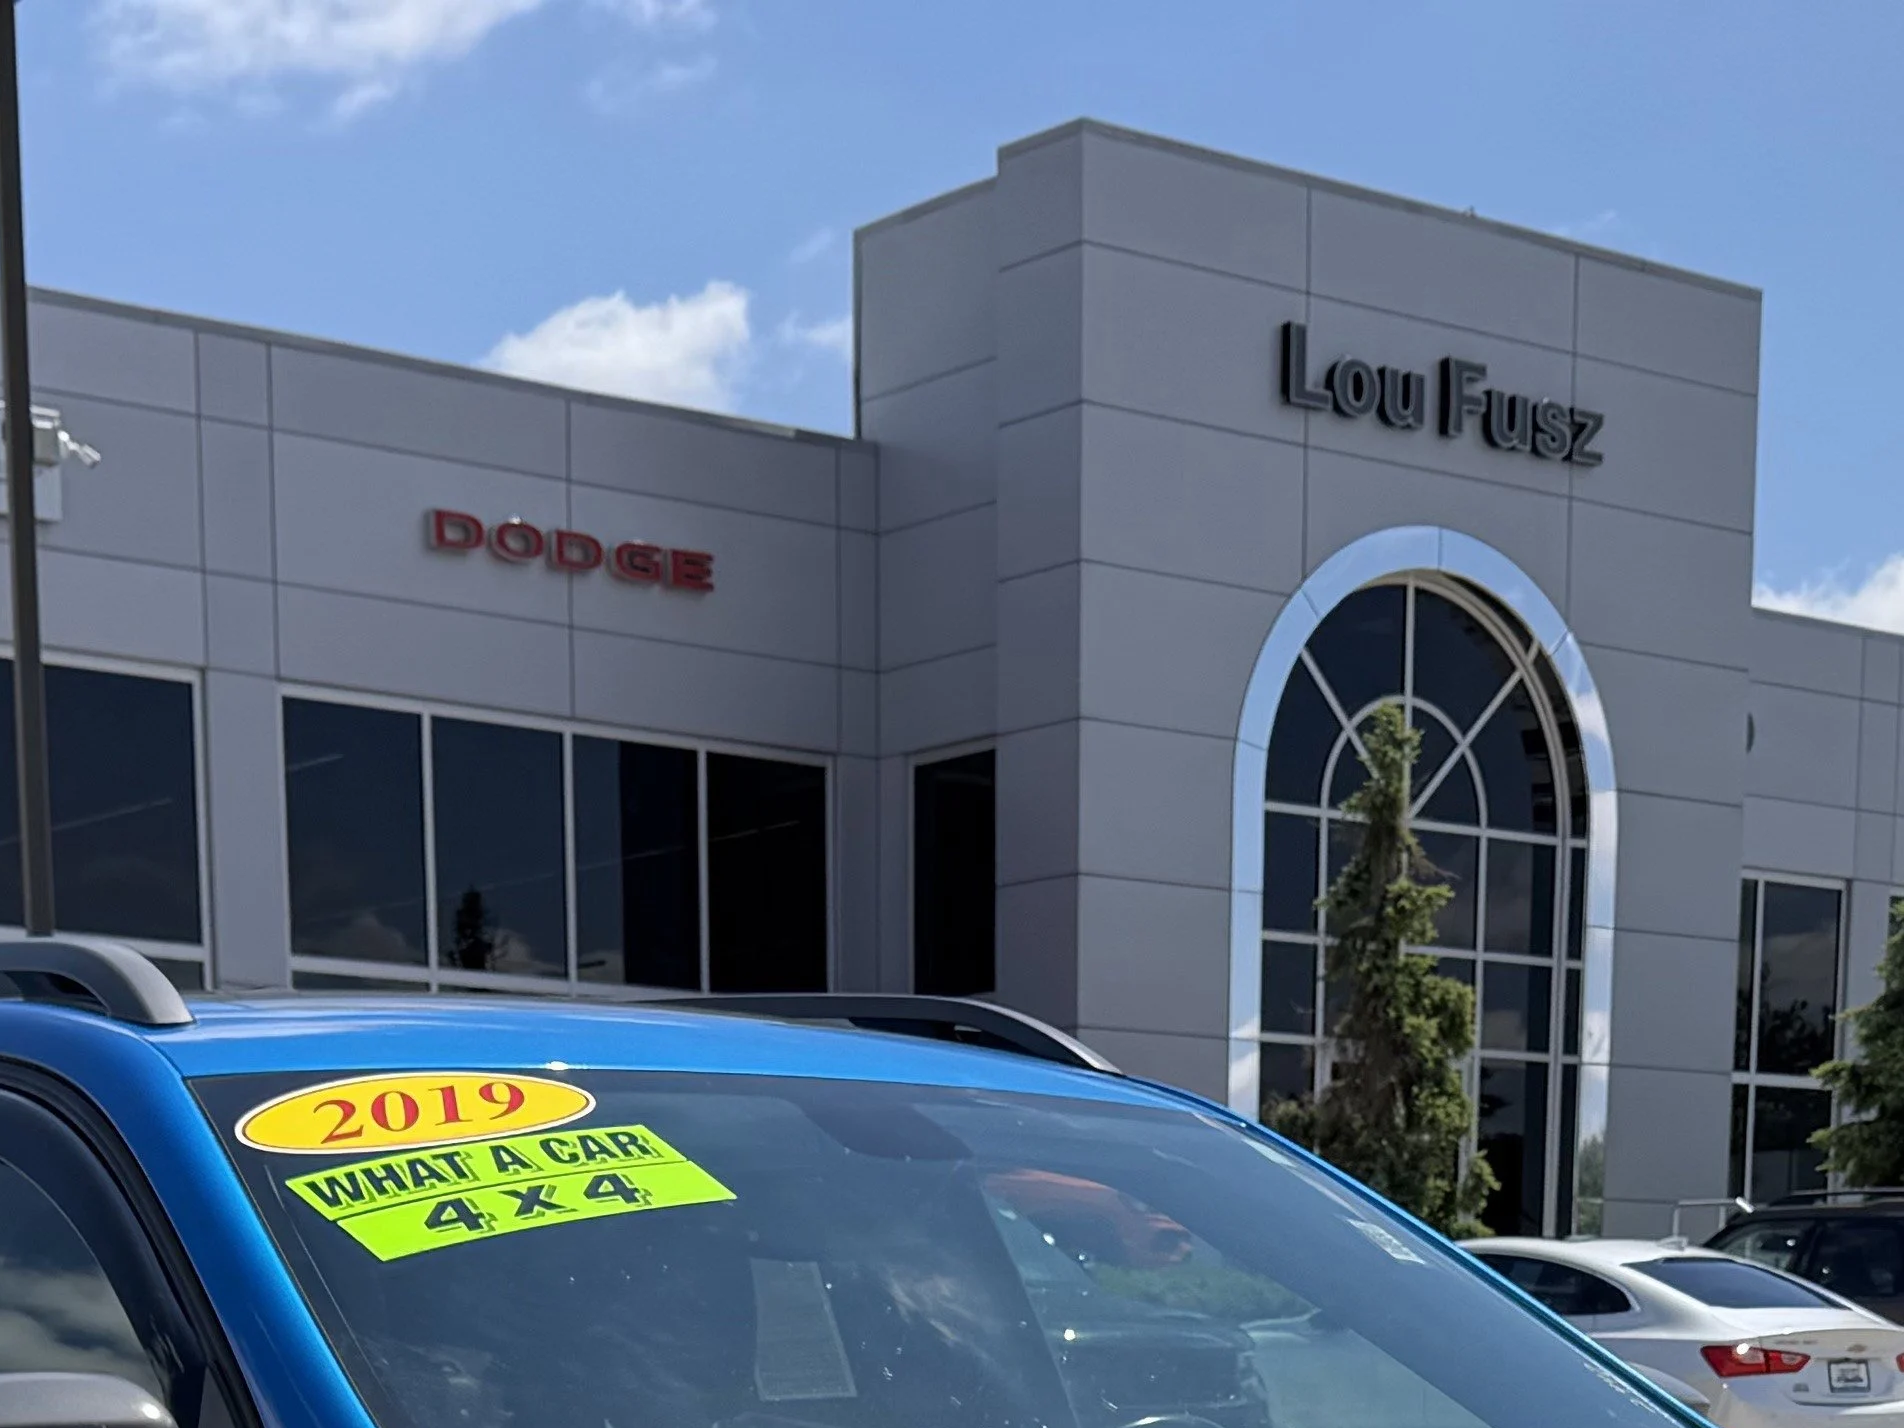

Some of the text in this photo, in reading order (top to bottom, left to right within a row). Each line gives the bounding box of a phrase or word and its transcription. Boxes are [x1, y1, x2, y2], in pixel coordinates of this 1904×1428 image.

[1280, 320, 1605, 467] Lou Fusz
[424, 506, 715, 594] DODGE
[313, 1080, 526, 1145] 2019
[305, 1131, 662, 1210] WHAT A CAR
